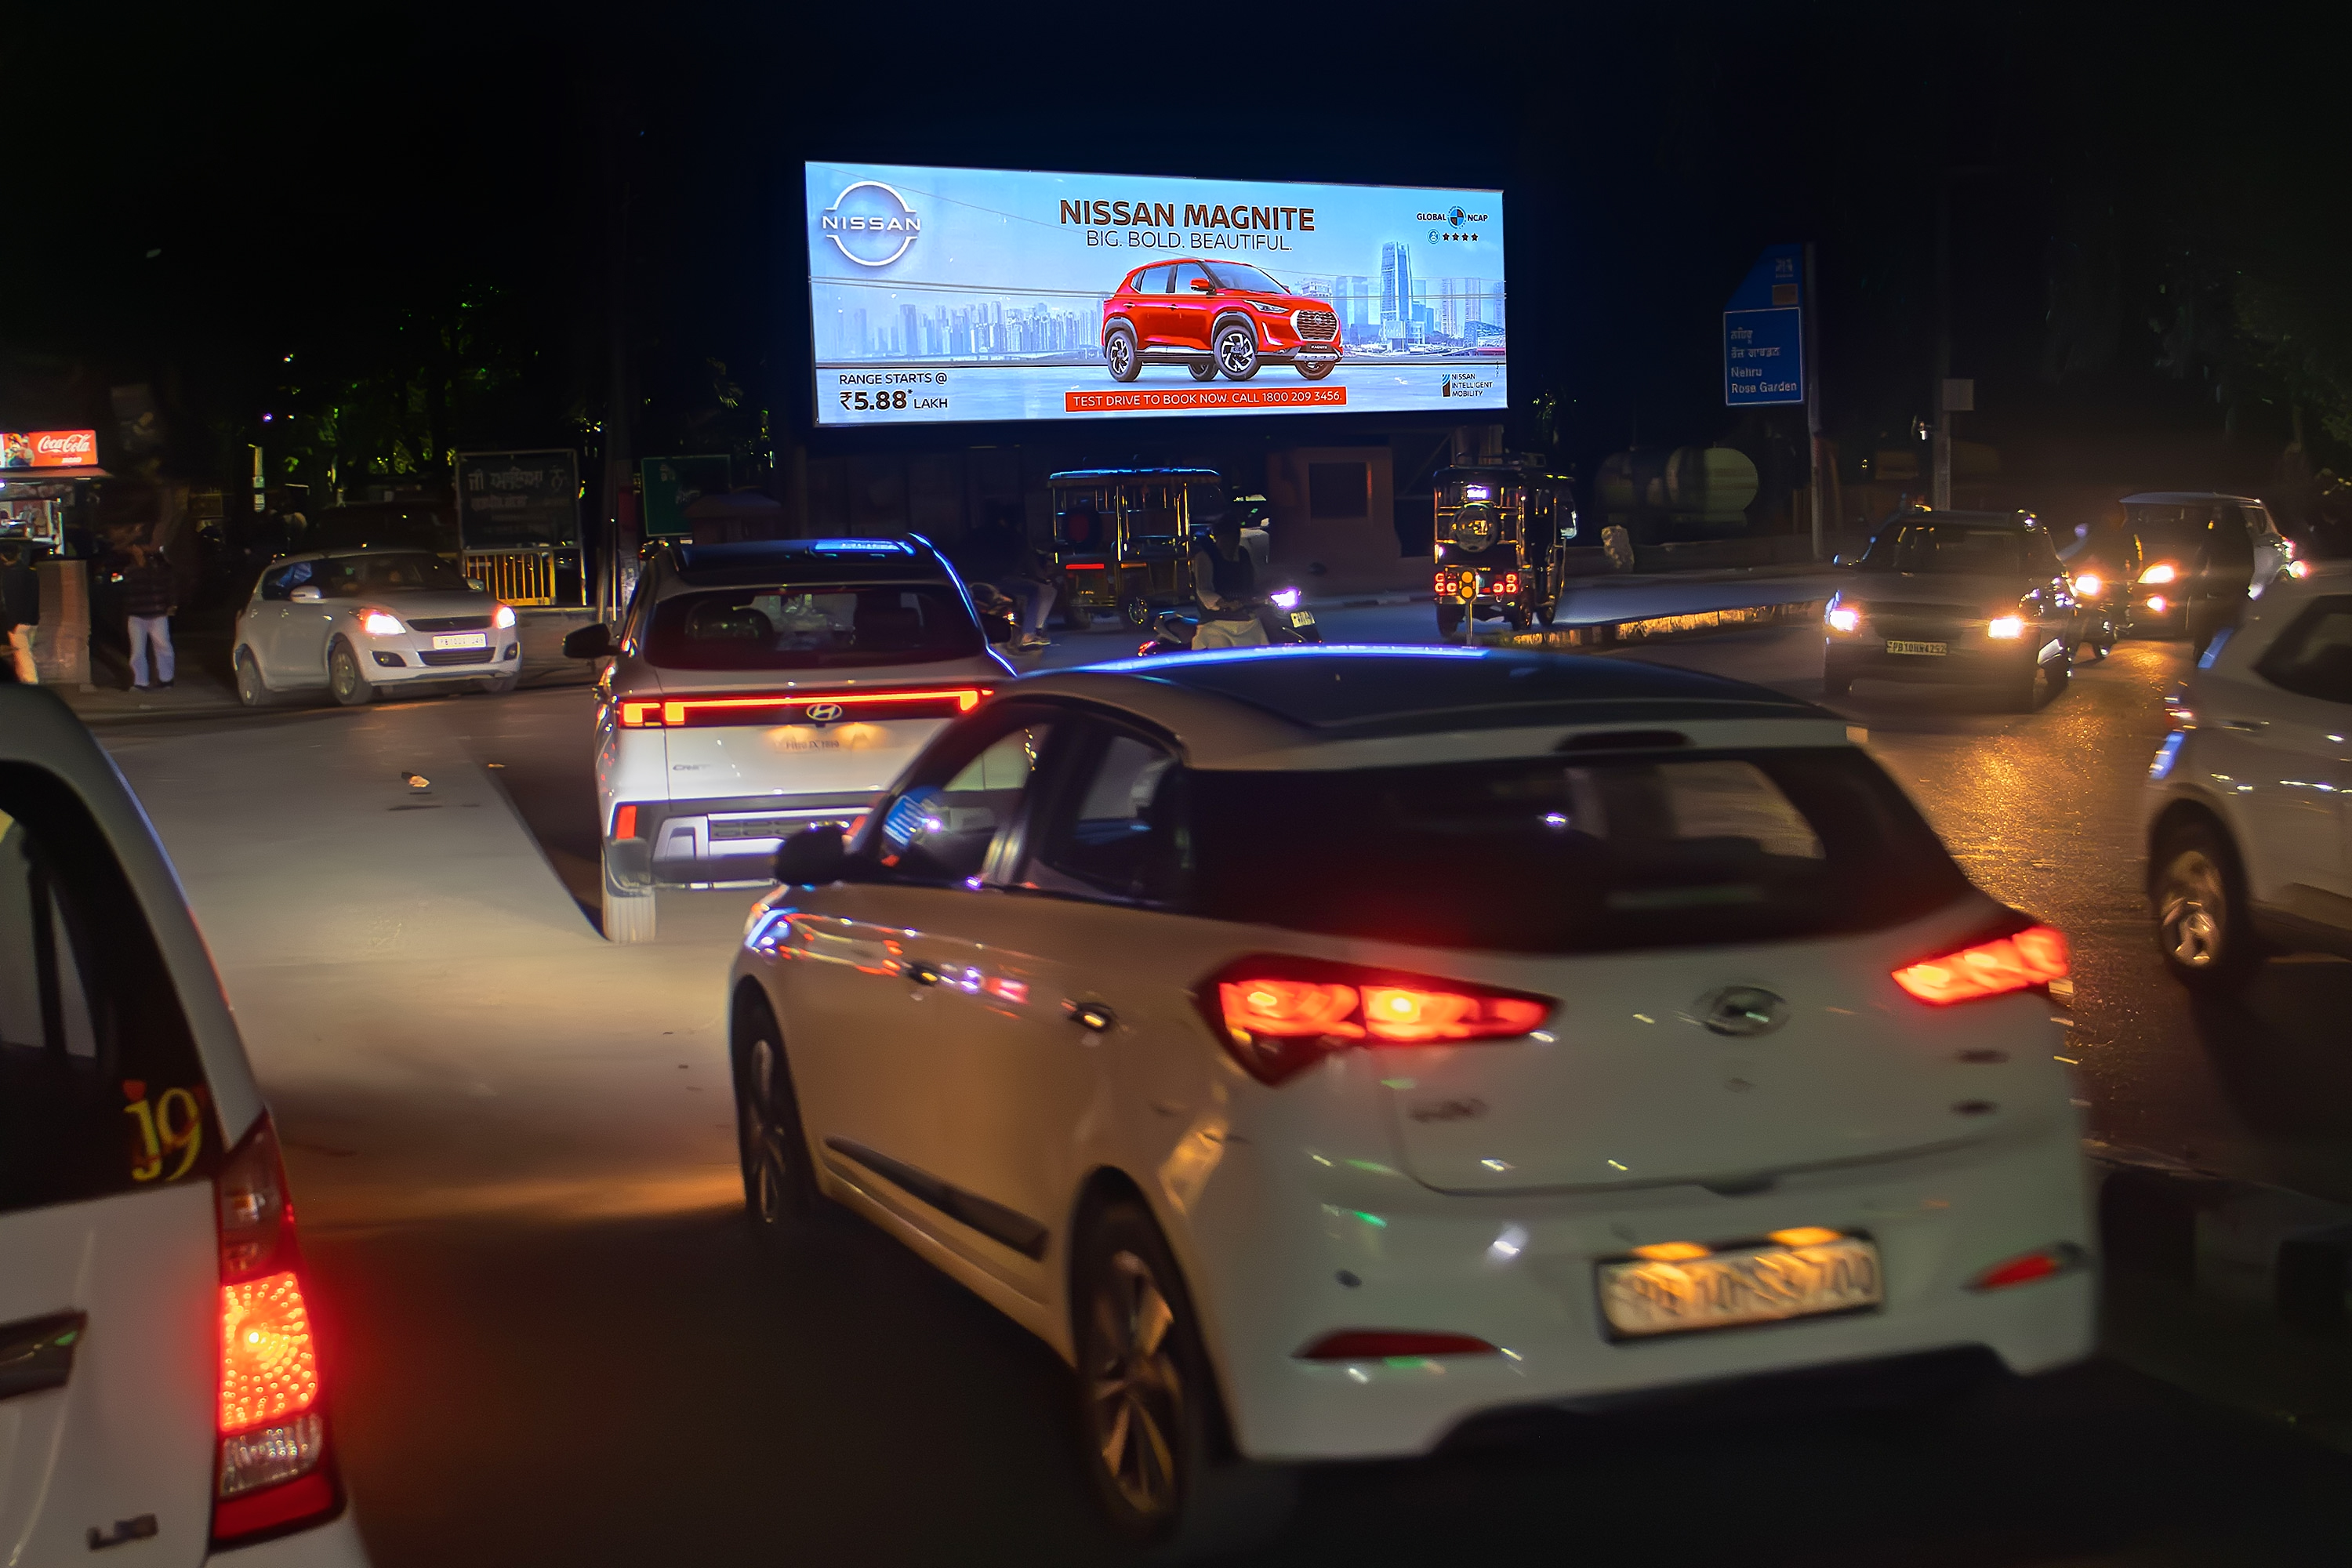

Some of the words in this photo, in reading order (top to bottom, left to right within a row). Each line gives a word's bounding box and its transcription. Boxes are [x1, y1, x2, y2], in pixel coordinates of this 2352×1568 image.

[1061, 199, 1174, 227] NISSAN
[1184, 203, 1315, 231] MAGNITE
[1416, 212, 1447, 221] GLOBAL
[822, 216, 921, 231] NISSAN
[1087, 230, 1123, 248] BIG.
[1128, 230, 1185, 249] BOLD.
[1191, 232, 1293, 251] BEAUTIFUL.
[840, 374, 883, 385] RANGE
[885, 372, 932, 384] STARTS
[935, 372, 947, 385] @
[1731, 367, 1762, 378] Nehru
[1759, 381, 1797, 392] Garden
[914, 398, 948, 408] LAKH
[1073, 396, 1103, 407] TEST
[1106, 395, 1141, 406] DRIVE
[1144, 394, 1160, 405] TO
[1163, 394, 1196, 405] BOOK
[1200, 393, 1229, 404] NOW.
[1232, 392, 1259, 404] CALL
[1261, 391, 1289, 403] 1800
[1291, 391, 1311, 402] 209
[1313, 390, 1342, 401] 3456.
